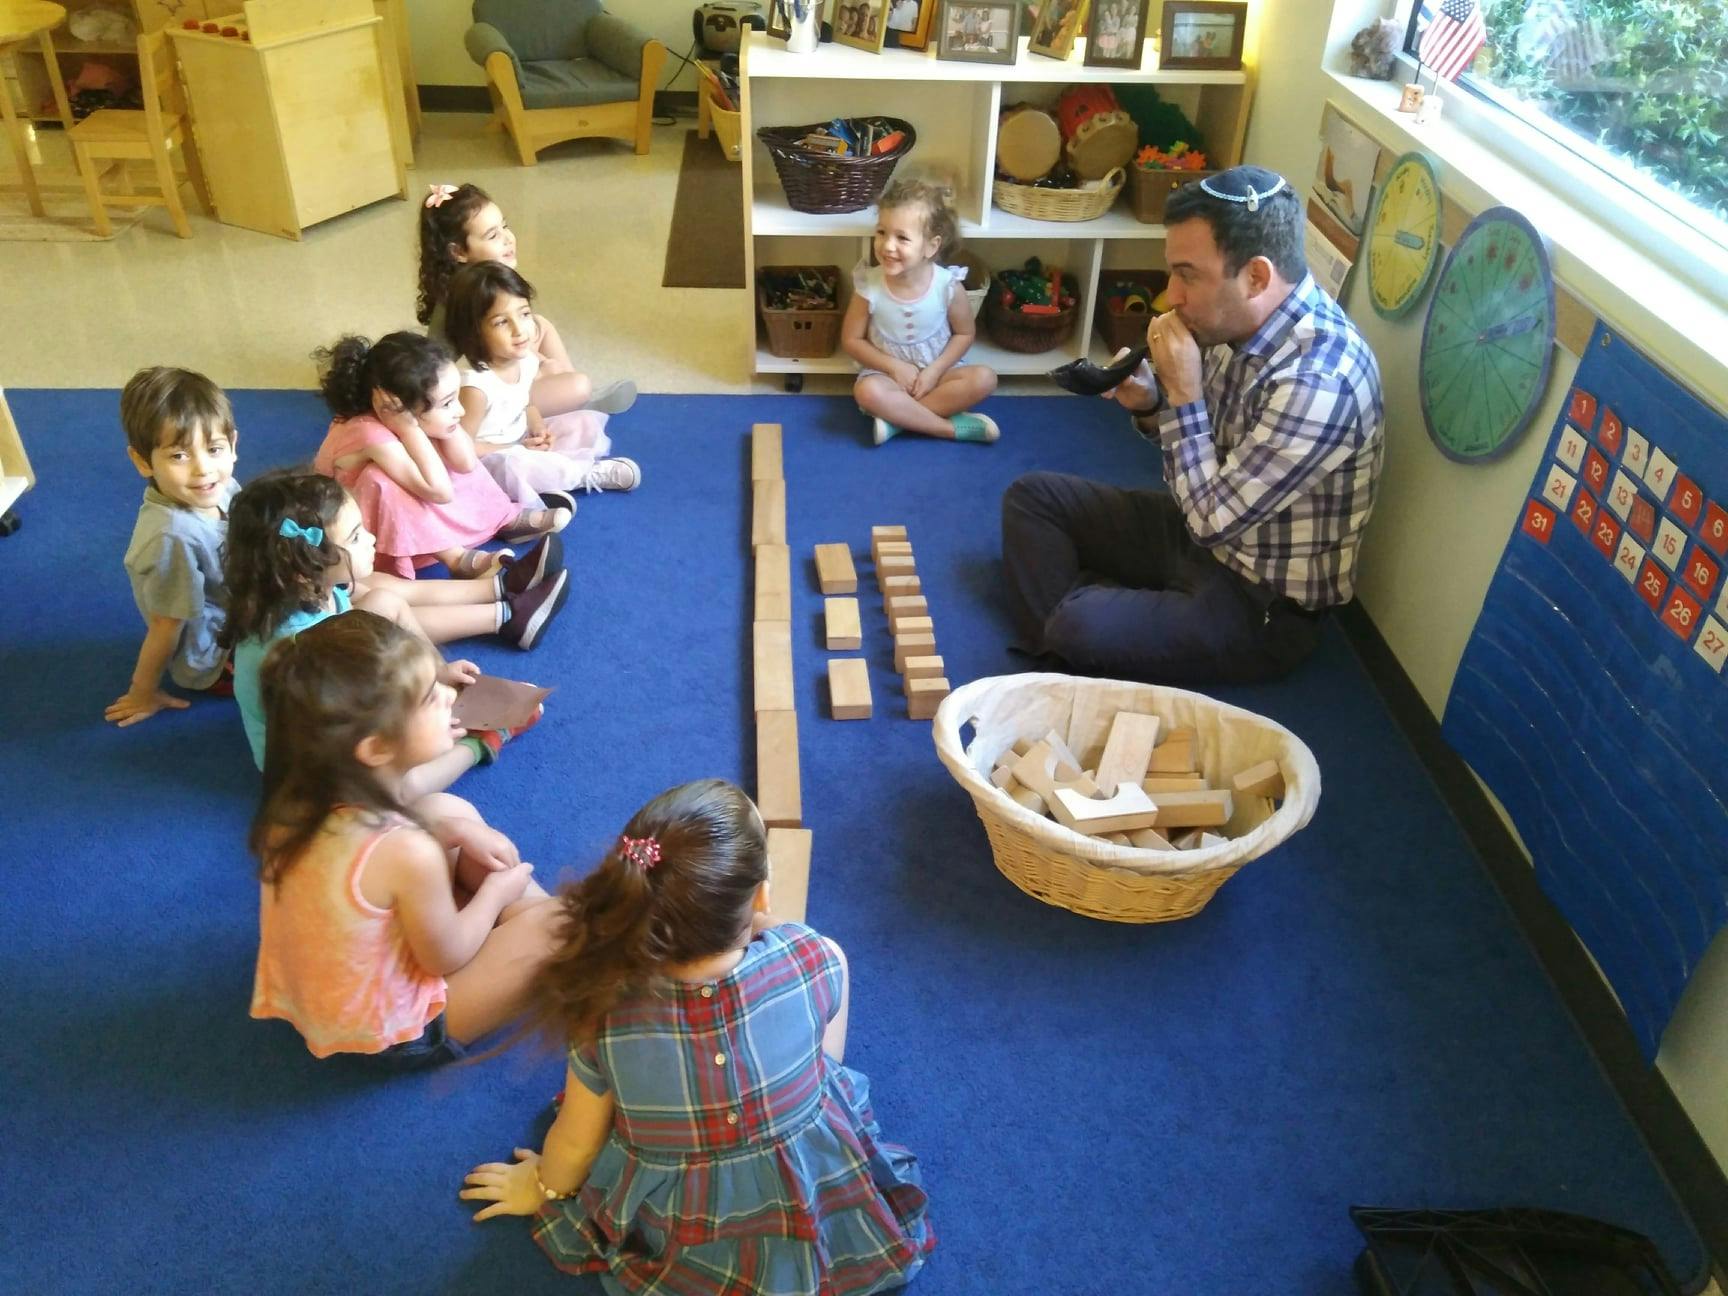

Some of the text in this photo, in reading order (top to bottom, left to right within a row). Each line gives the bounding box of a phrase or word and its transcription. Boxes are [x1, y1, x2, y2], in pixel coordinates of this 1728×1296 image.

[1531, 512, 1548, 532] 31
[1566, 440, 1710, 585] 11 12 13 15 16
[1607, 421, 1616, 440] 2
[1632, 444, 1641, 462] 3
[1654, 468, 1664, 484] 4
[1682, 490, 1694, 509] 5
[1712, 518, 1724, 538] 6
[1551, 478, 1725, 654] 21 22 23 24 25 26 27
